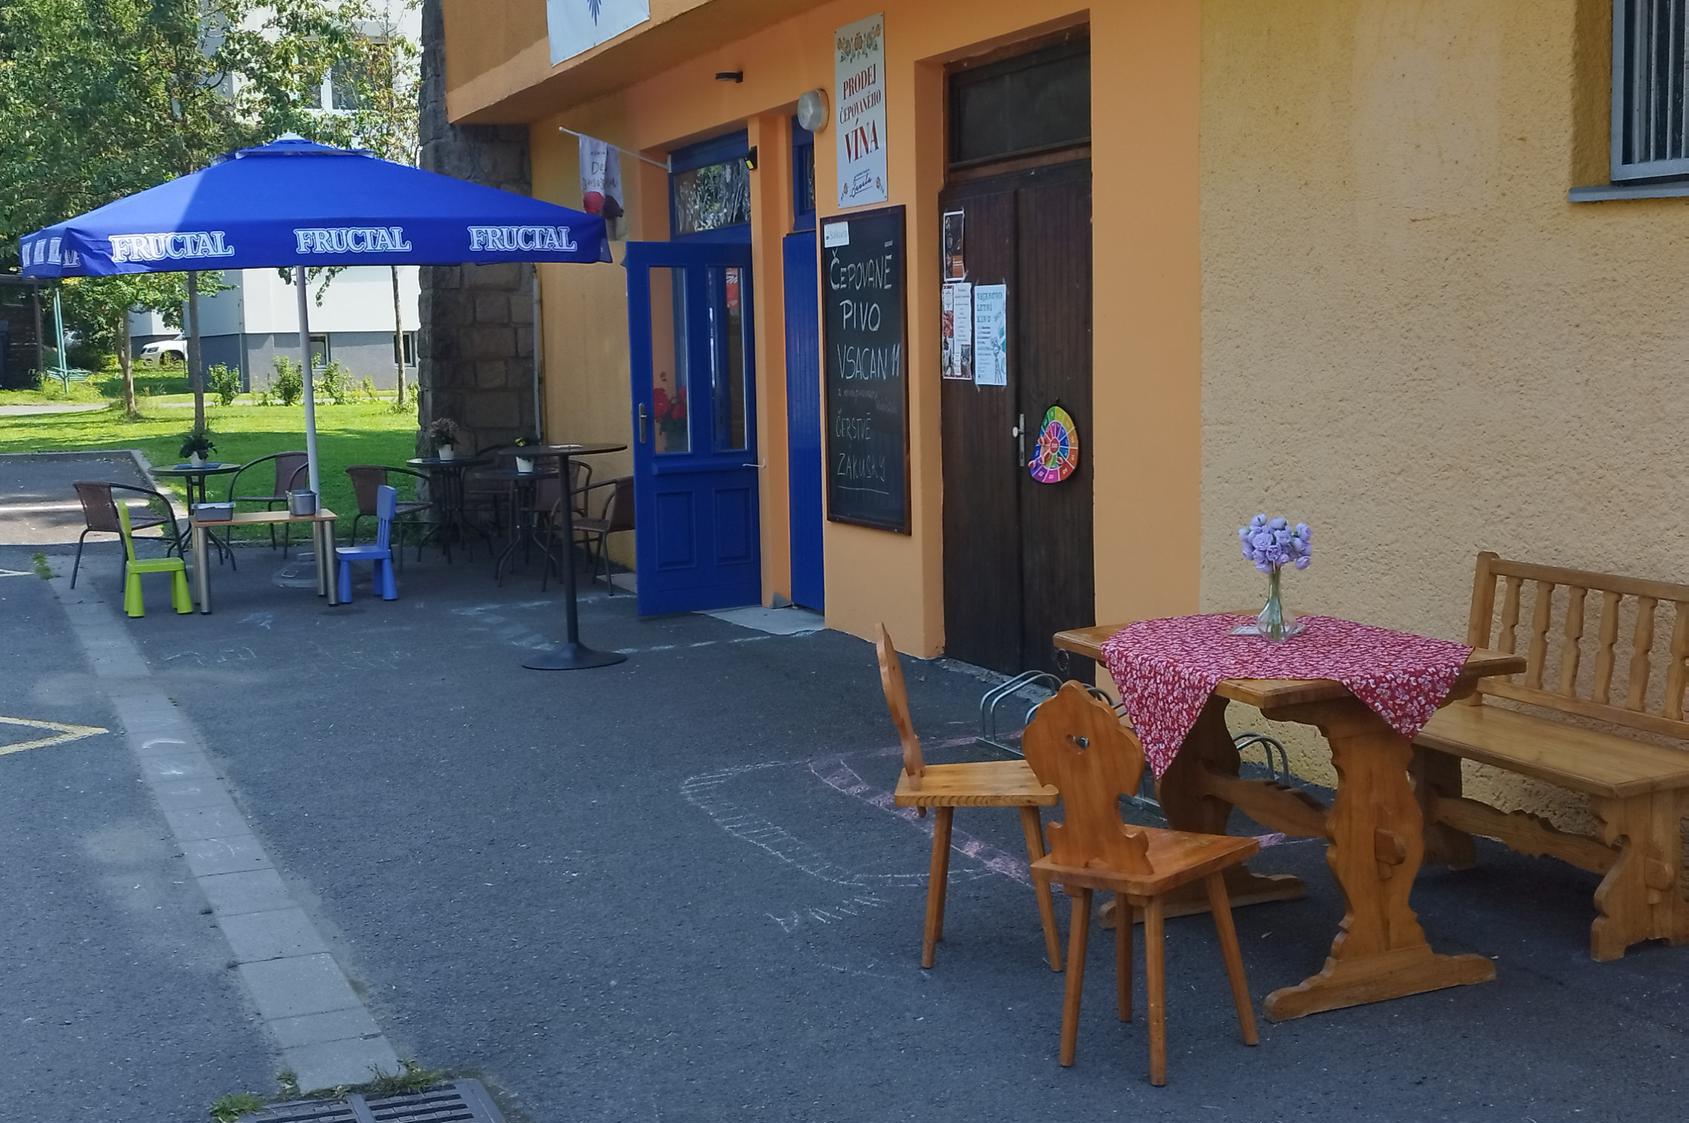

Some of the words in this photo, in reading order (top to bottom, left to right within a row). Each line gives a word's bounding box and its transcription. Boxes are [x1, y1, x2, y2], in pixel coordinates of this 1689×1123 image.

[843, 64, 877, 100] PRODEJ
[840, 89, 882, 125] ČEPOVANÉHO
[844, 117, 880, 164] VÍNA
[108, 231, 235, 263] FRUCTAL
[294, 226, 412, 254] FRUCTAL
[467, 226, 577, 253] FRUCTAL
[830, 240, 893, 290] ČEPOVANÉ
[839, 299, 881, 332] PIVO
[836, 343, 887, 380] VSACAN
